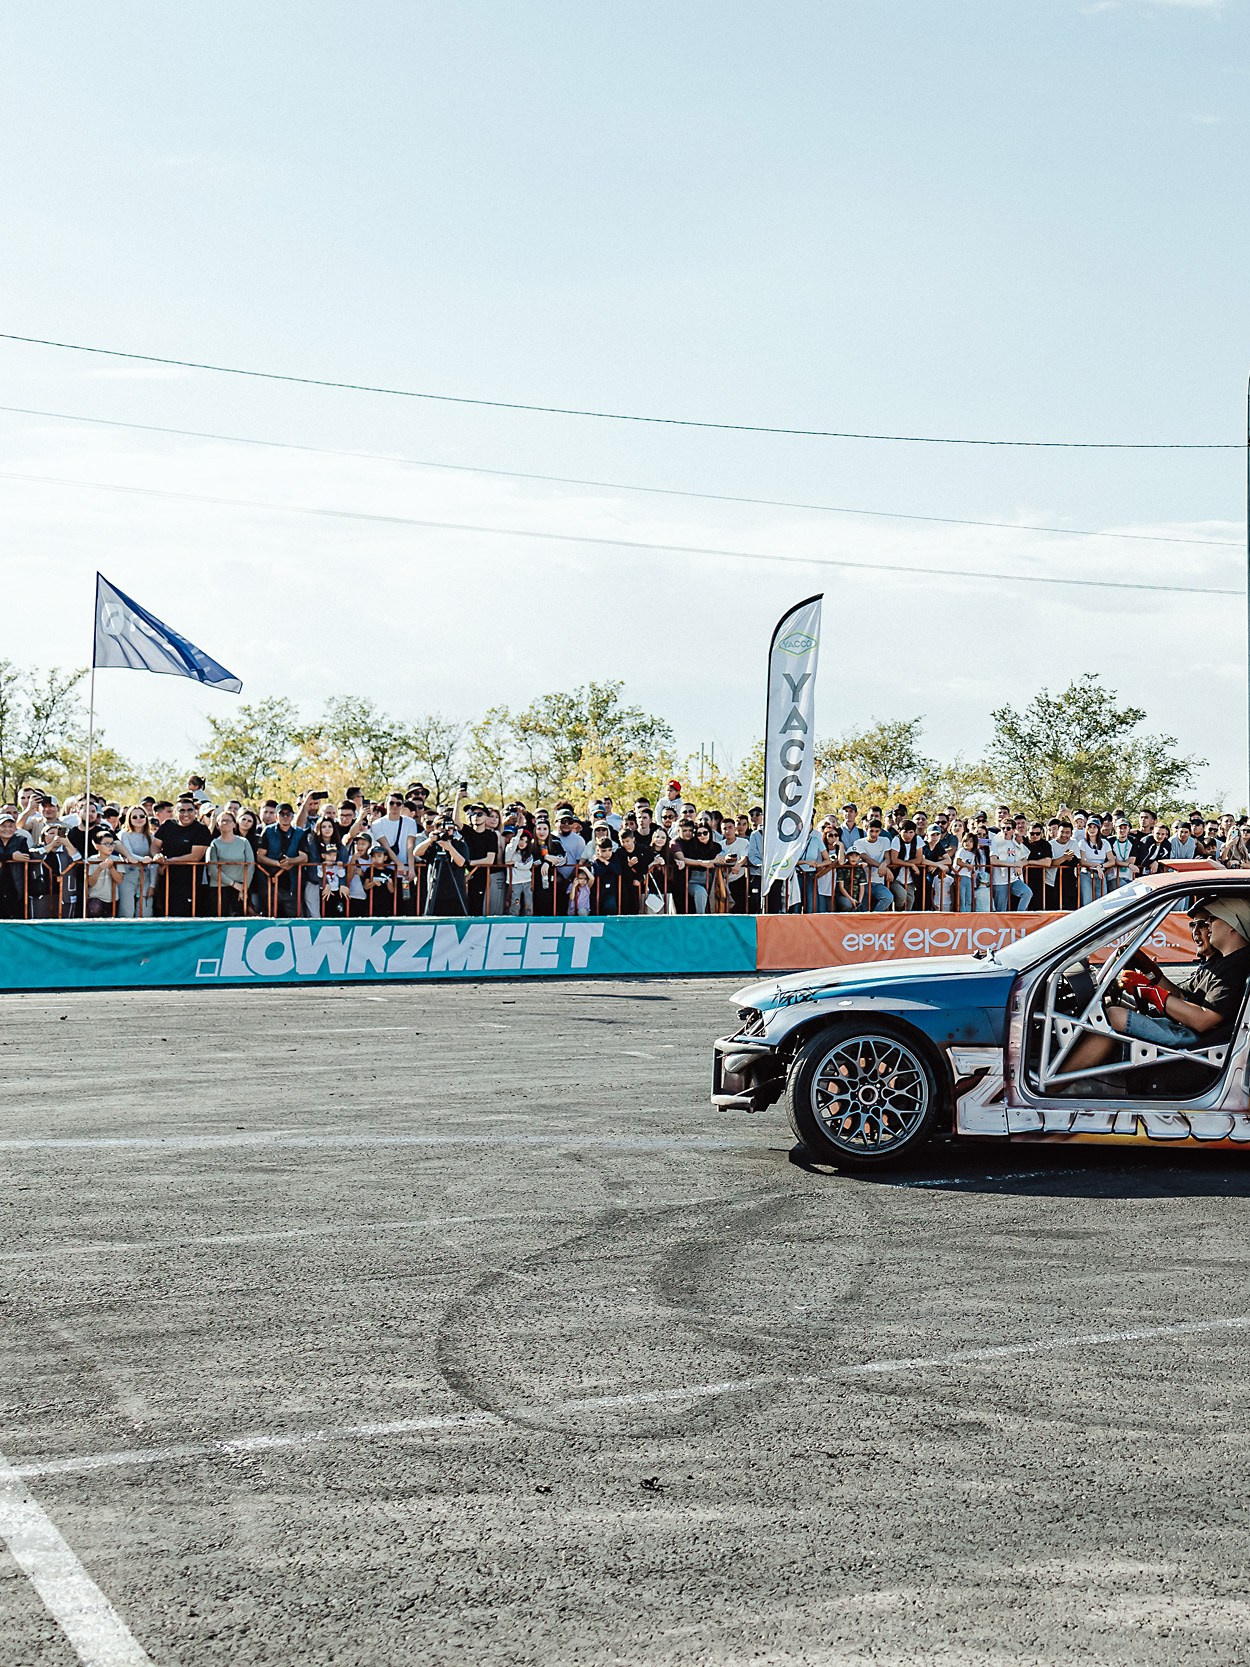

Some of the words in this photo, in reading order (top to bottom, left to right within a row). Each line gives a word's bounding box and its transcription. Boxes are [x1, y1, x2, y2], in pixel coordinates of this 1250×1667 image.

[782, 640, 813, 648] YACCO
[778, 673, 812, 843] YACCO
[219, 922, 605, 977] LOWKZMEET
